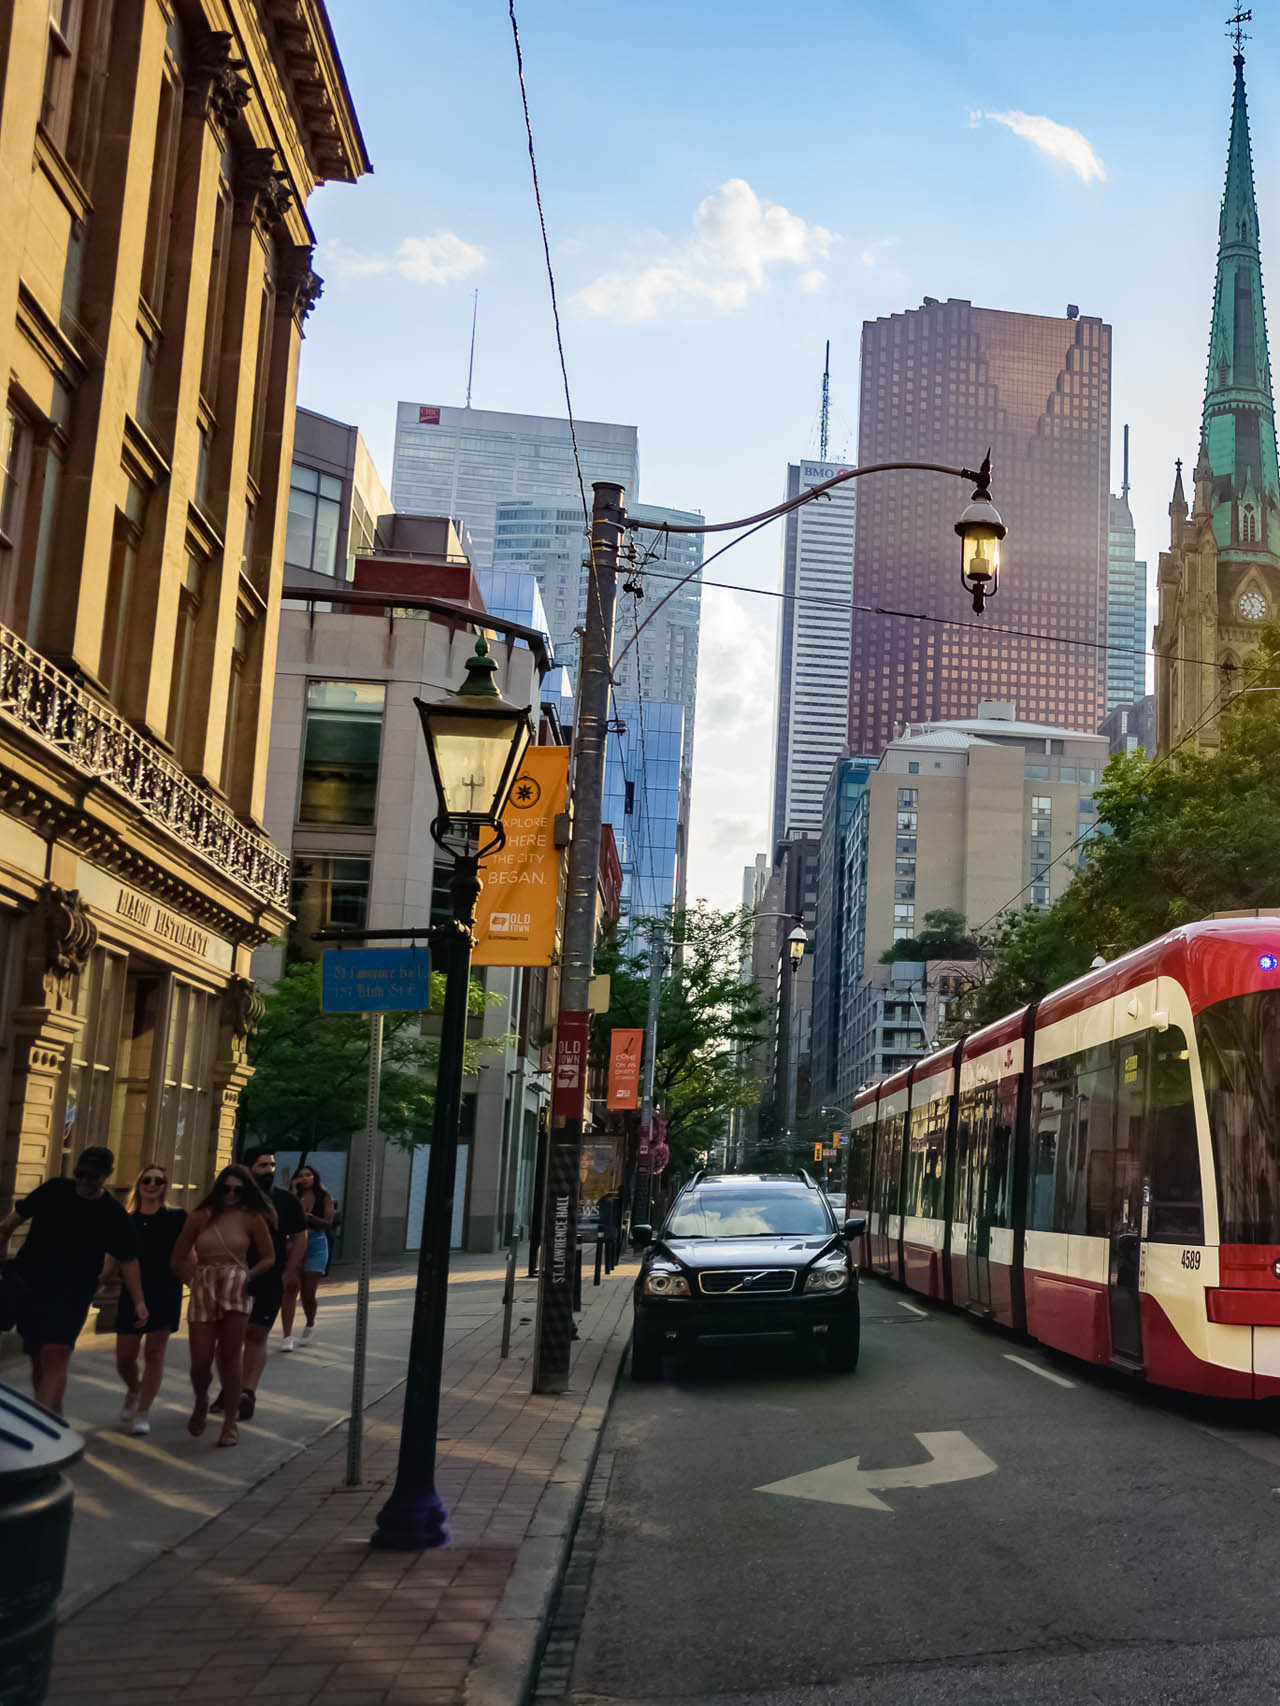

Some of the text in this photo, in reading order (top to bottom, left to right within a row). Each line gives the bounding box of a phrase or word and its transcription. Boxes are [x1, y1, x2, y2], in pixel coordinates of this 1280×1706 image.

[804, 467, 834, 478] BMO
[502, 817, 549, 828] XPLORE
[506, 834, 547, 847] HERE
[493, 853, 544, 864] THE CITY
[488, 871, 548, 884] BEGAN.
[510, 913, 531, 925] OLD
[559, 1041, 581, 1054] OLD
[560, 1055, 581, 1064] OWN
[556, 1195, 569, 1218] HALL
[553, 1220, 568, 1268] LAWRENCE
[1181, 1250, 1200, 1270] 4589
